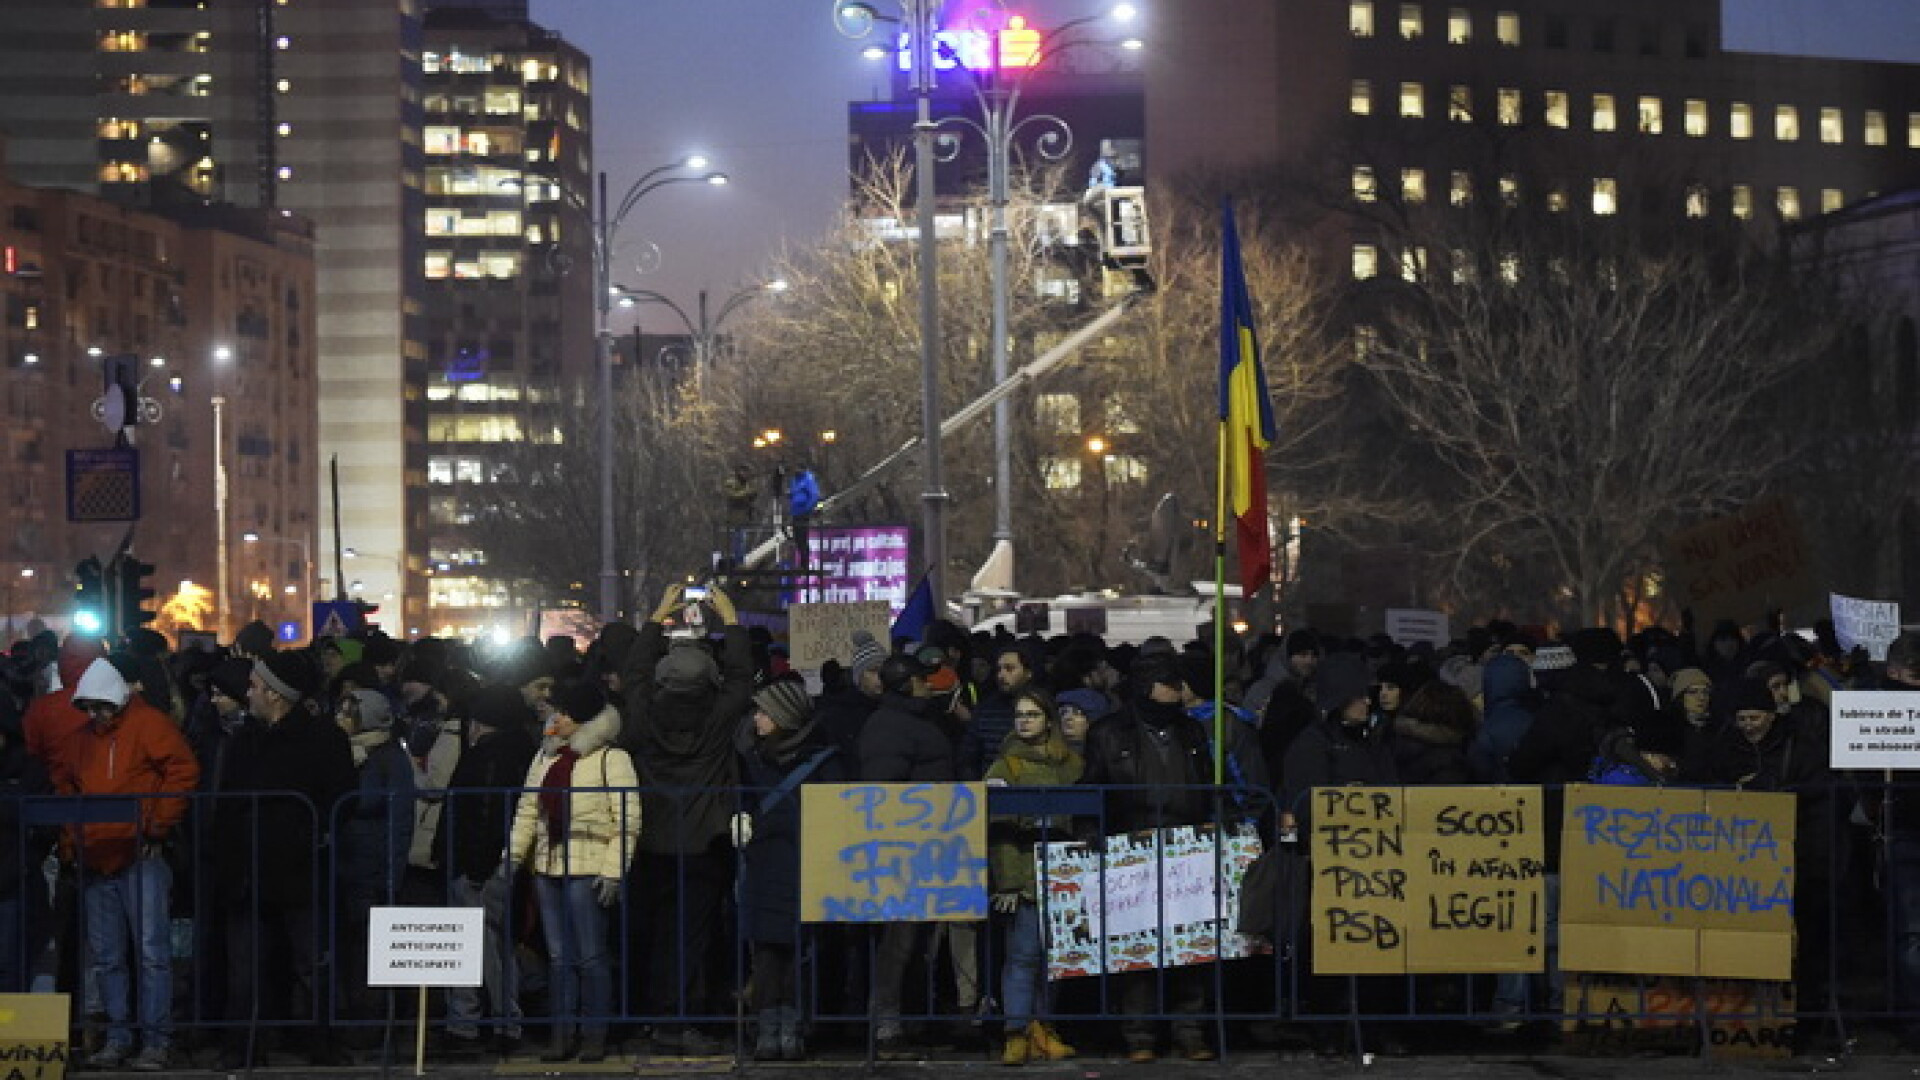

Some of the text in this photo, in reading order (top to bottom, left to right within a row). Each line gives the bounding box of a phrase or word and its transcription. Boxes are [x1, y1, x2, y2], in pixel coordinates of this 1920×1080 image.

[1887, 707, 1903, 719] de
[1318, 789, 1394, 820] PCR
[1318, 824, 1404, 859] FSN
[1319, 866, 1408, 902] PDSR
[390, 923, 464, 933] ANTICIPATE!
[389, 941, 464, 951] ANTICIPATE!
[389, 959, 462, 969] ANTICIPATE!
